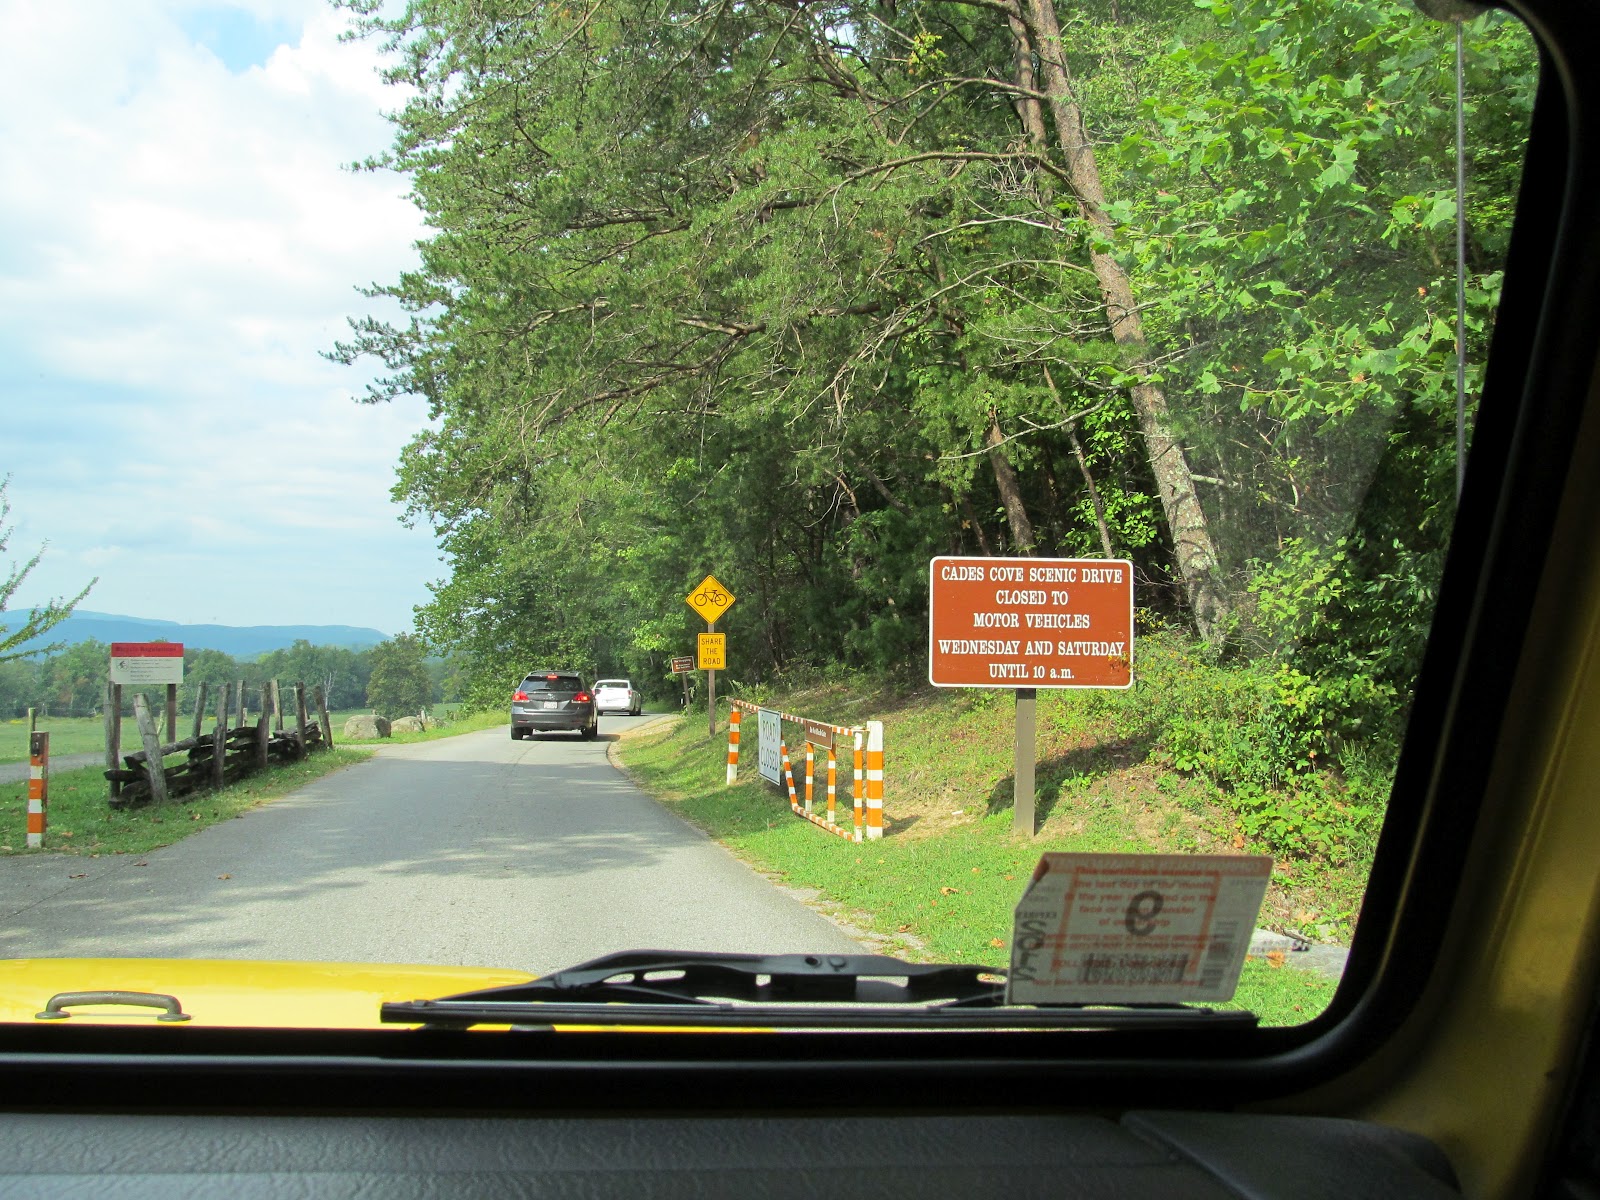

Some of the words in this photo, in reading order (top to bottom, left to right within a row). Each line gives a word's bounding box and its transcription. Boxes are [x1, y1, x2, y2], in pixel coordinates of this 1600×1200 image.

[941, 566, 985, 582] CADES
[989, 566, 1024, 583] COVE
[1029, 567, 1077, 583] SCENIC
[1081, 568, 1123, 584] DRIVE
[995, 590, 1047, 605] CLOSED
[1051, 591, 1069, 606] TO
[973, 613, 1020, 628] MOTOR
[1025, 614, 1090, 629] VEHICLES
[701, 637, 723, 646] SHARE
[938, 639, 1020, 655] WEDNESDAY
[1024, 640, 1053, 656] AND
[1057, 641, 1125, 657] SATURDAY
[705, 647, 718, 655] THE
[703, 657, 721, 666] ROAD
[988, 663, 1029, 679] UNTIL
[1033, 665, 1045, 678] 10
[1050, 668, 1075, 679] a.m.
[762, 720, 776, 743] ROAD
